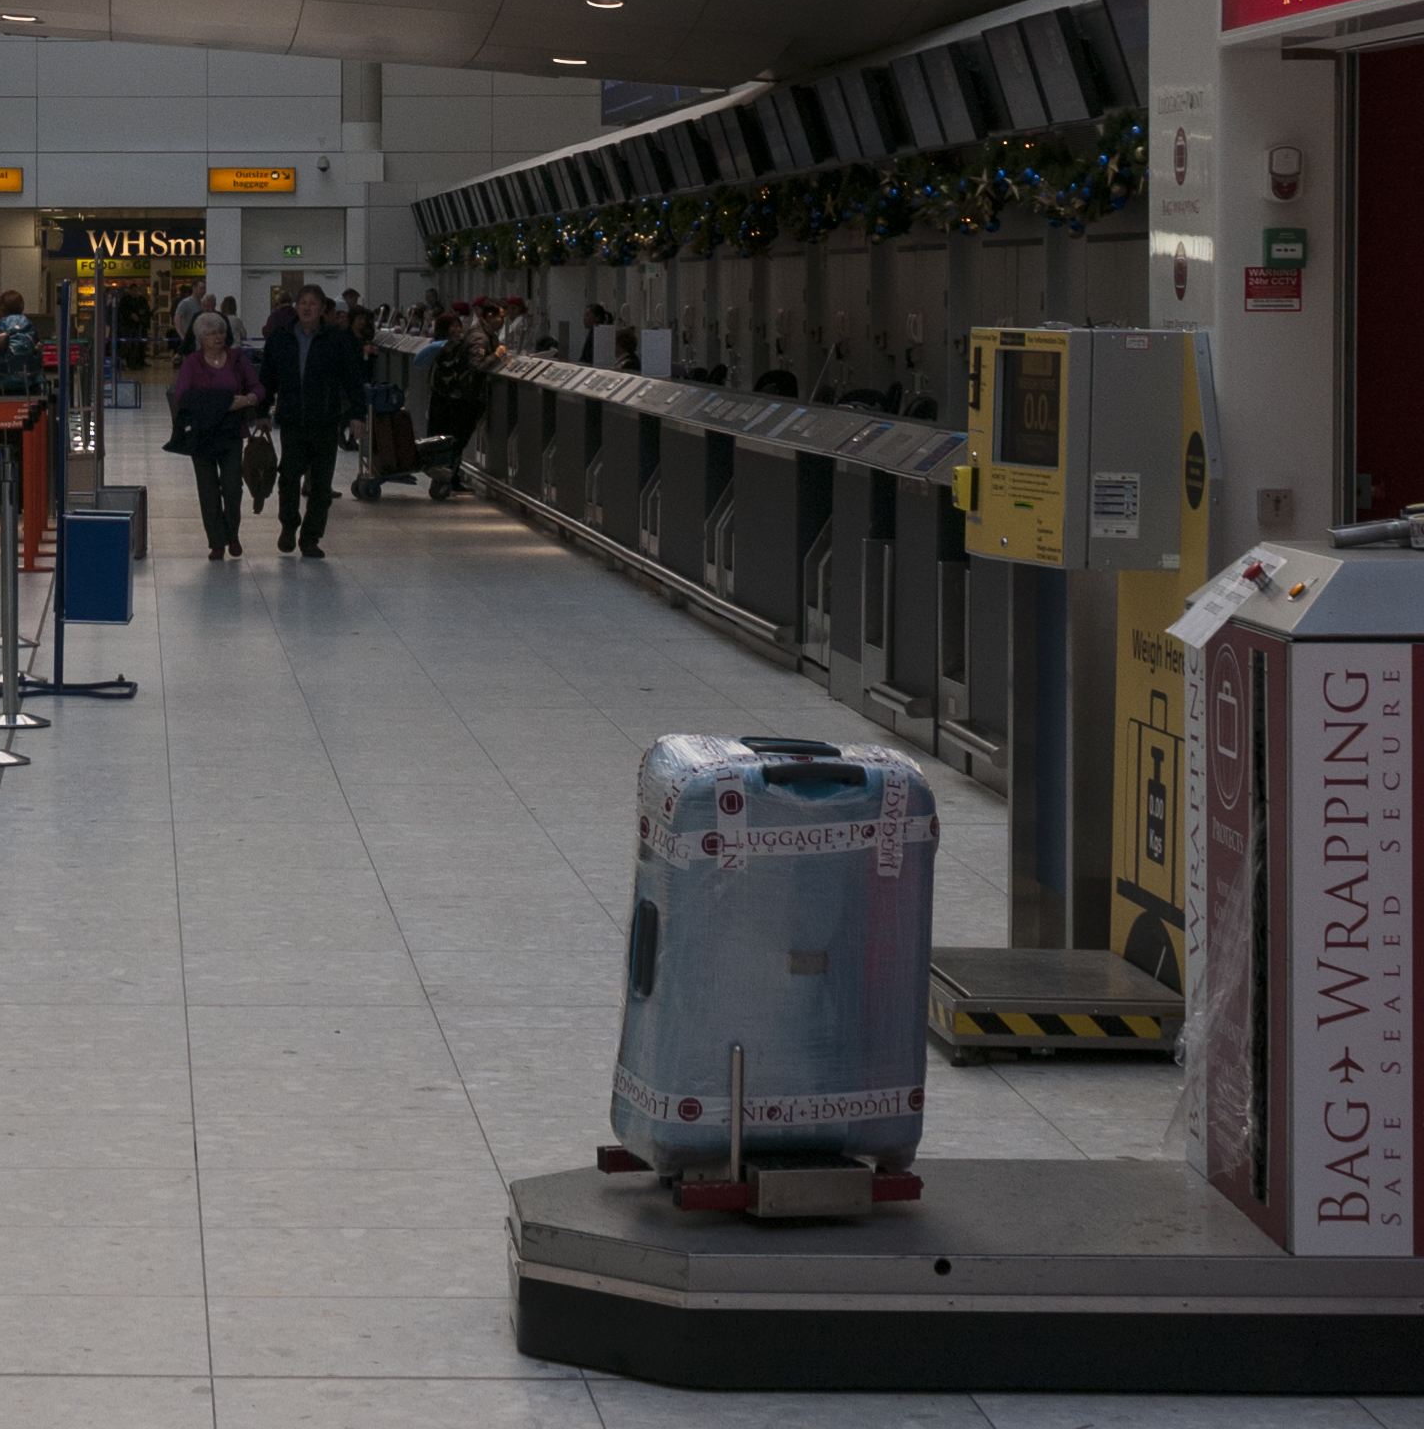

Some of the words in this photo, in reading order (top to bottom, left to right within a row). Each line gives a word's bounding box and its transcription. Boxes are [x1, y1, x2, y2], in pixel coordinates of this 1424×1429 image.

[233, 180, 269, 189] baggage
[235, 171, 269, 179] Outsize
[86, 229, 206, 257] WHSmi
[1248, 268, 1298, 277] WARNING
[1248, 277, 1269, 286] 24hr
[1271, 277, 1297, 286] CCTV
[1132, 628, 1162, 674] Weigh
[1382, 669, 1401, 853] SECURE
[1212, 816, 1244, 856] PROTECTS
[1317, 669, 1370, 1032] WRAPPING
[1382, 894, 1401, 1075] SEALED
[741, 1104, 794, 1124] POIN
[811, 1097, 902, 1120] LUGGAGE
[1318, 1098, 1370, 1227] BAG
[1382, 1116, 1401, 1227] SAFE
